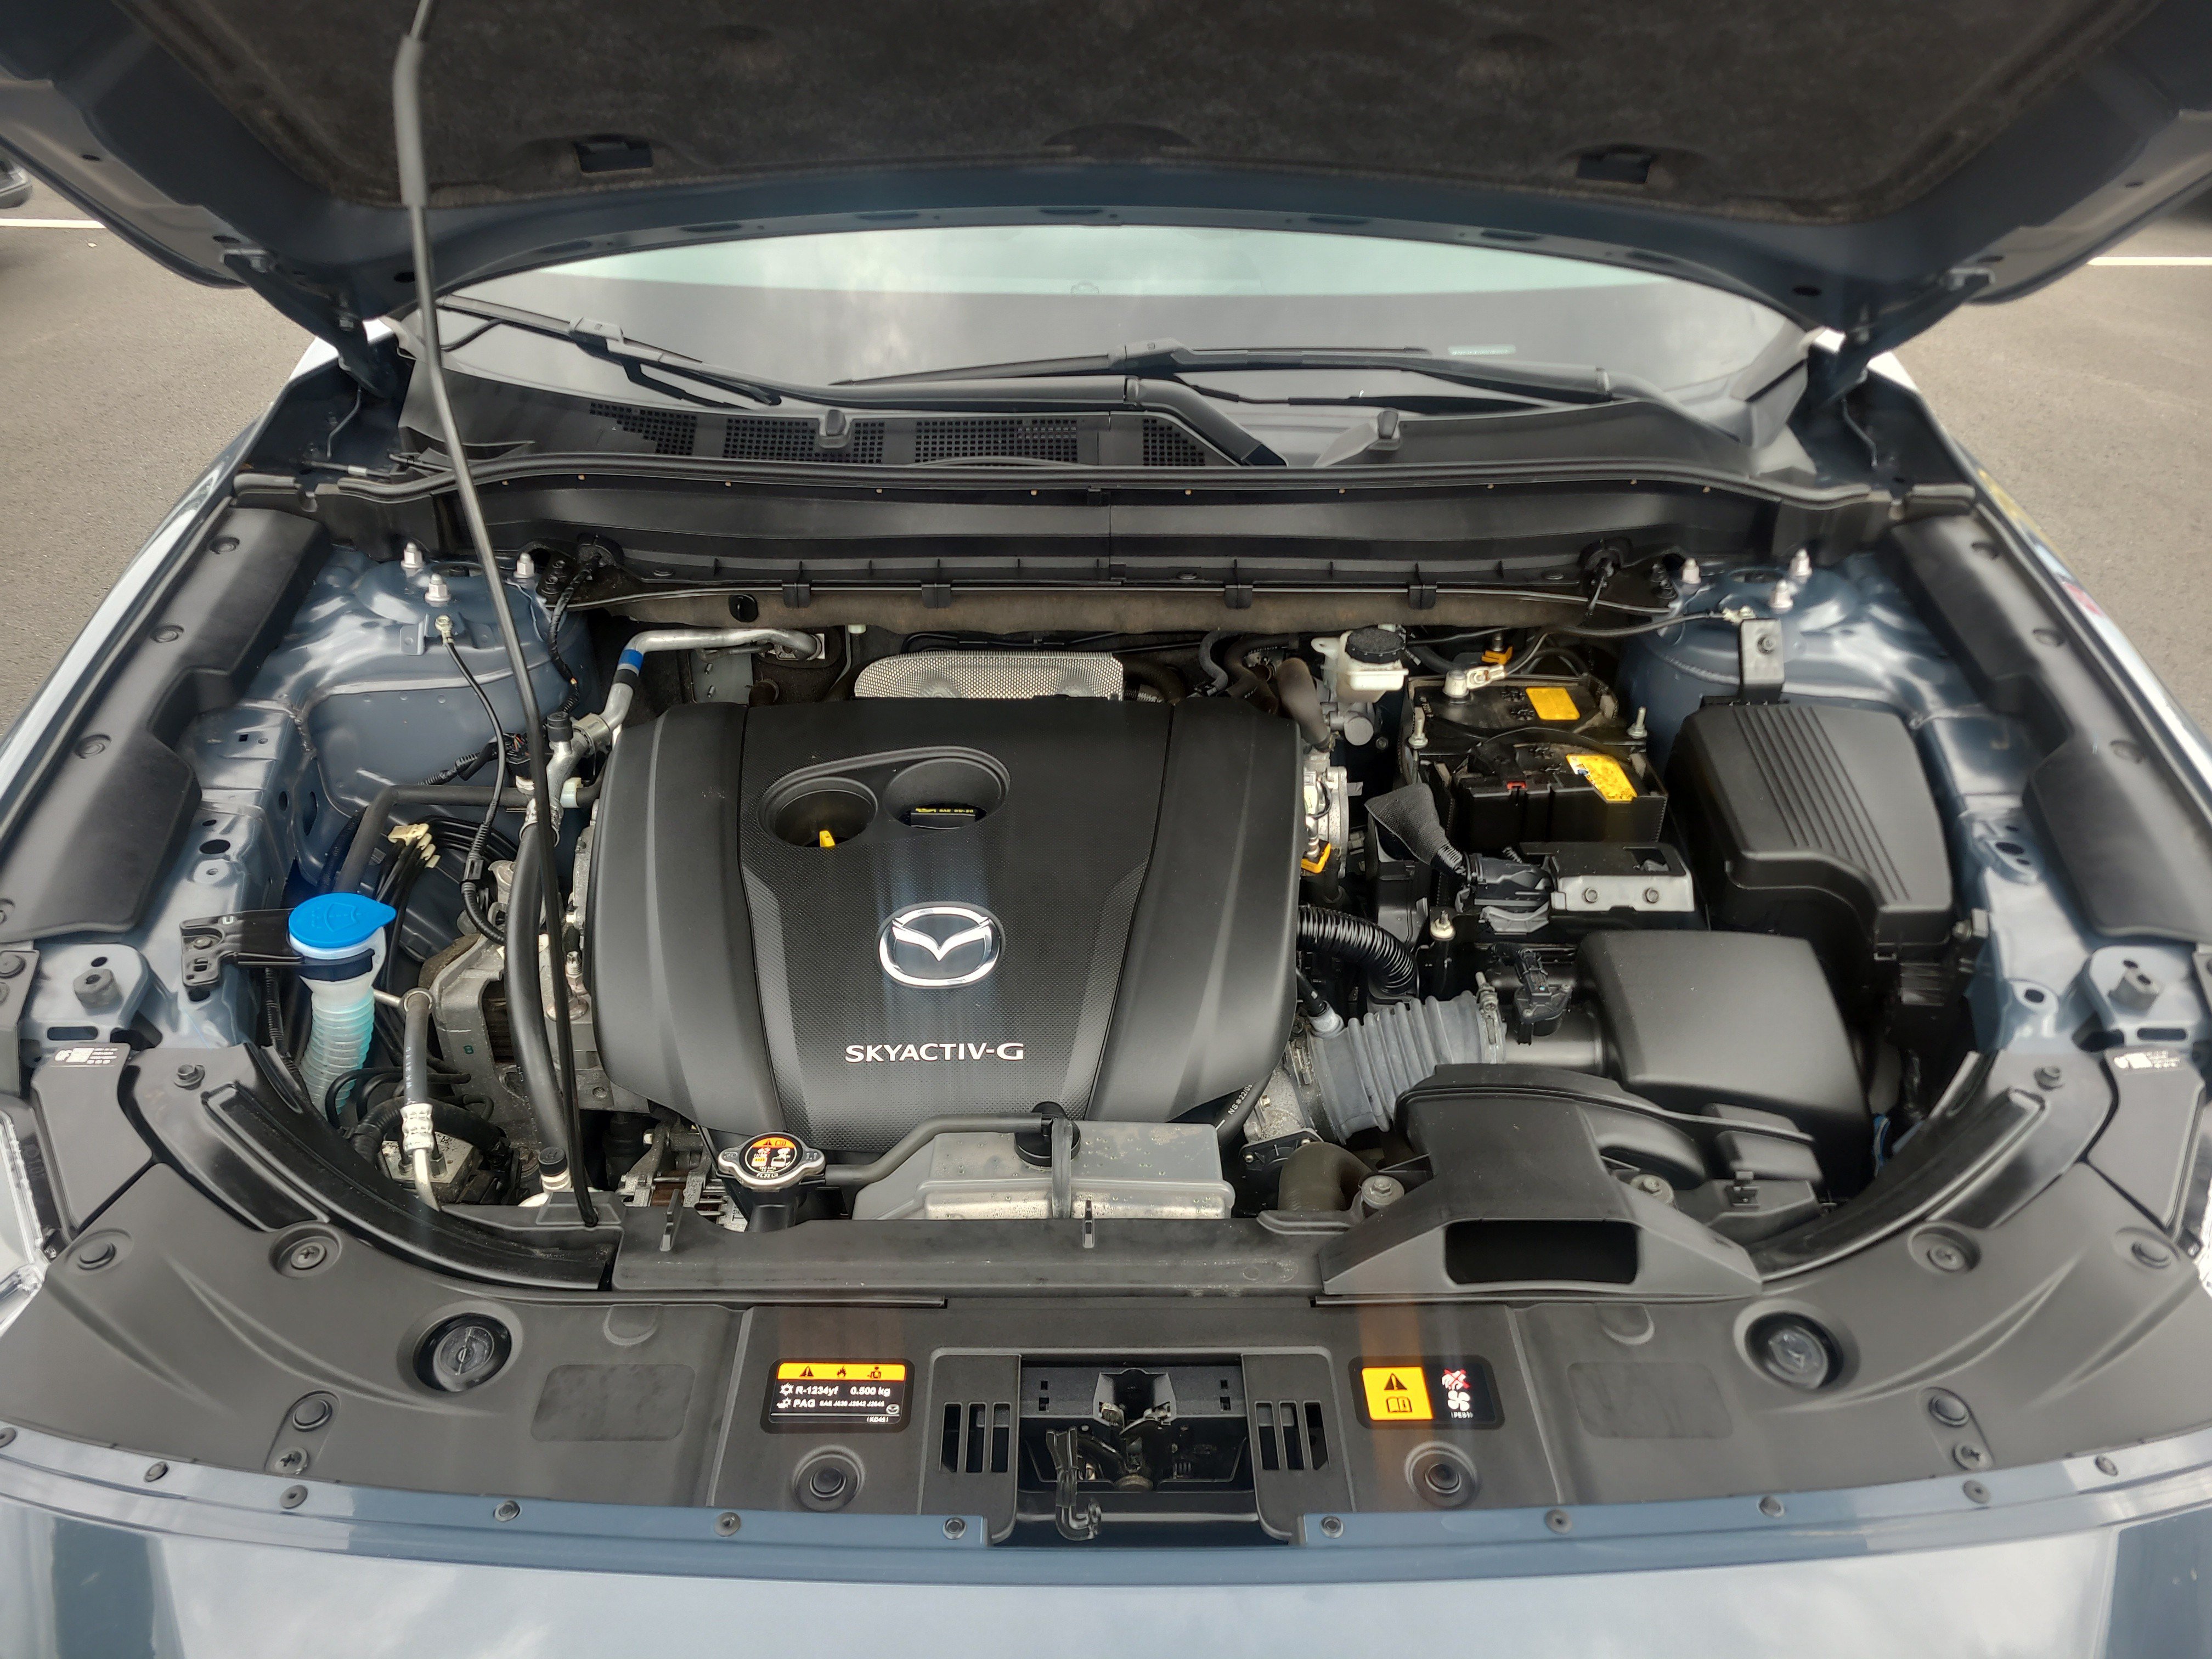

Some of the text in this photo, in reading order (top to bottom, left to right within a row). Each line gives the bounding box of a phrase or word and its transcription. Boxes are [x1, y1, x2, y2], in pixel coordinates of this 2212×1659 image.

[845, 1042, 1024, 1063] SKYACTIV-G
[795, 1385, 839, 1396] R-1234yf
[878, 1386, 891, 1397] kg
[793, 1398, 815, 1408] PAG
